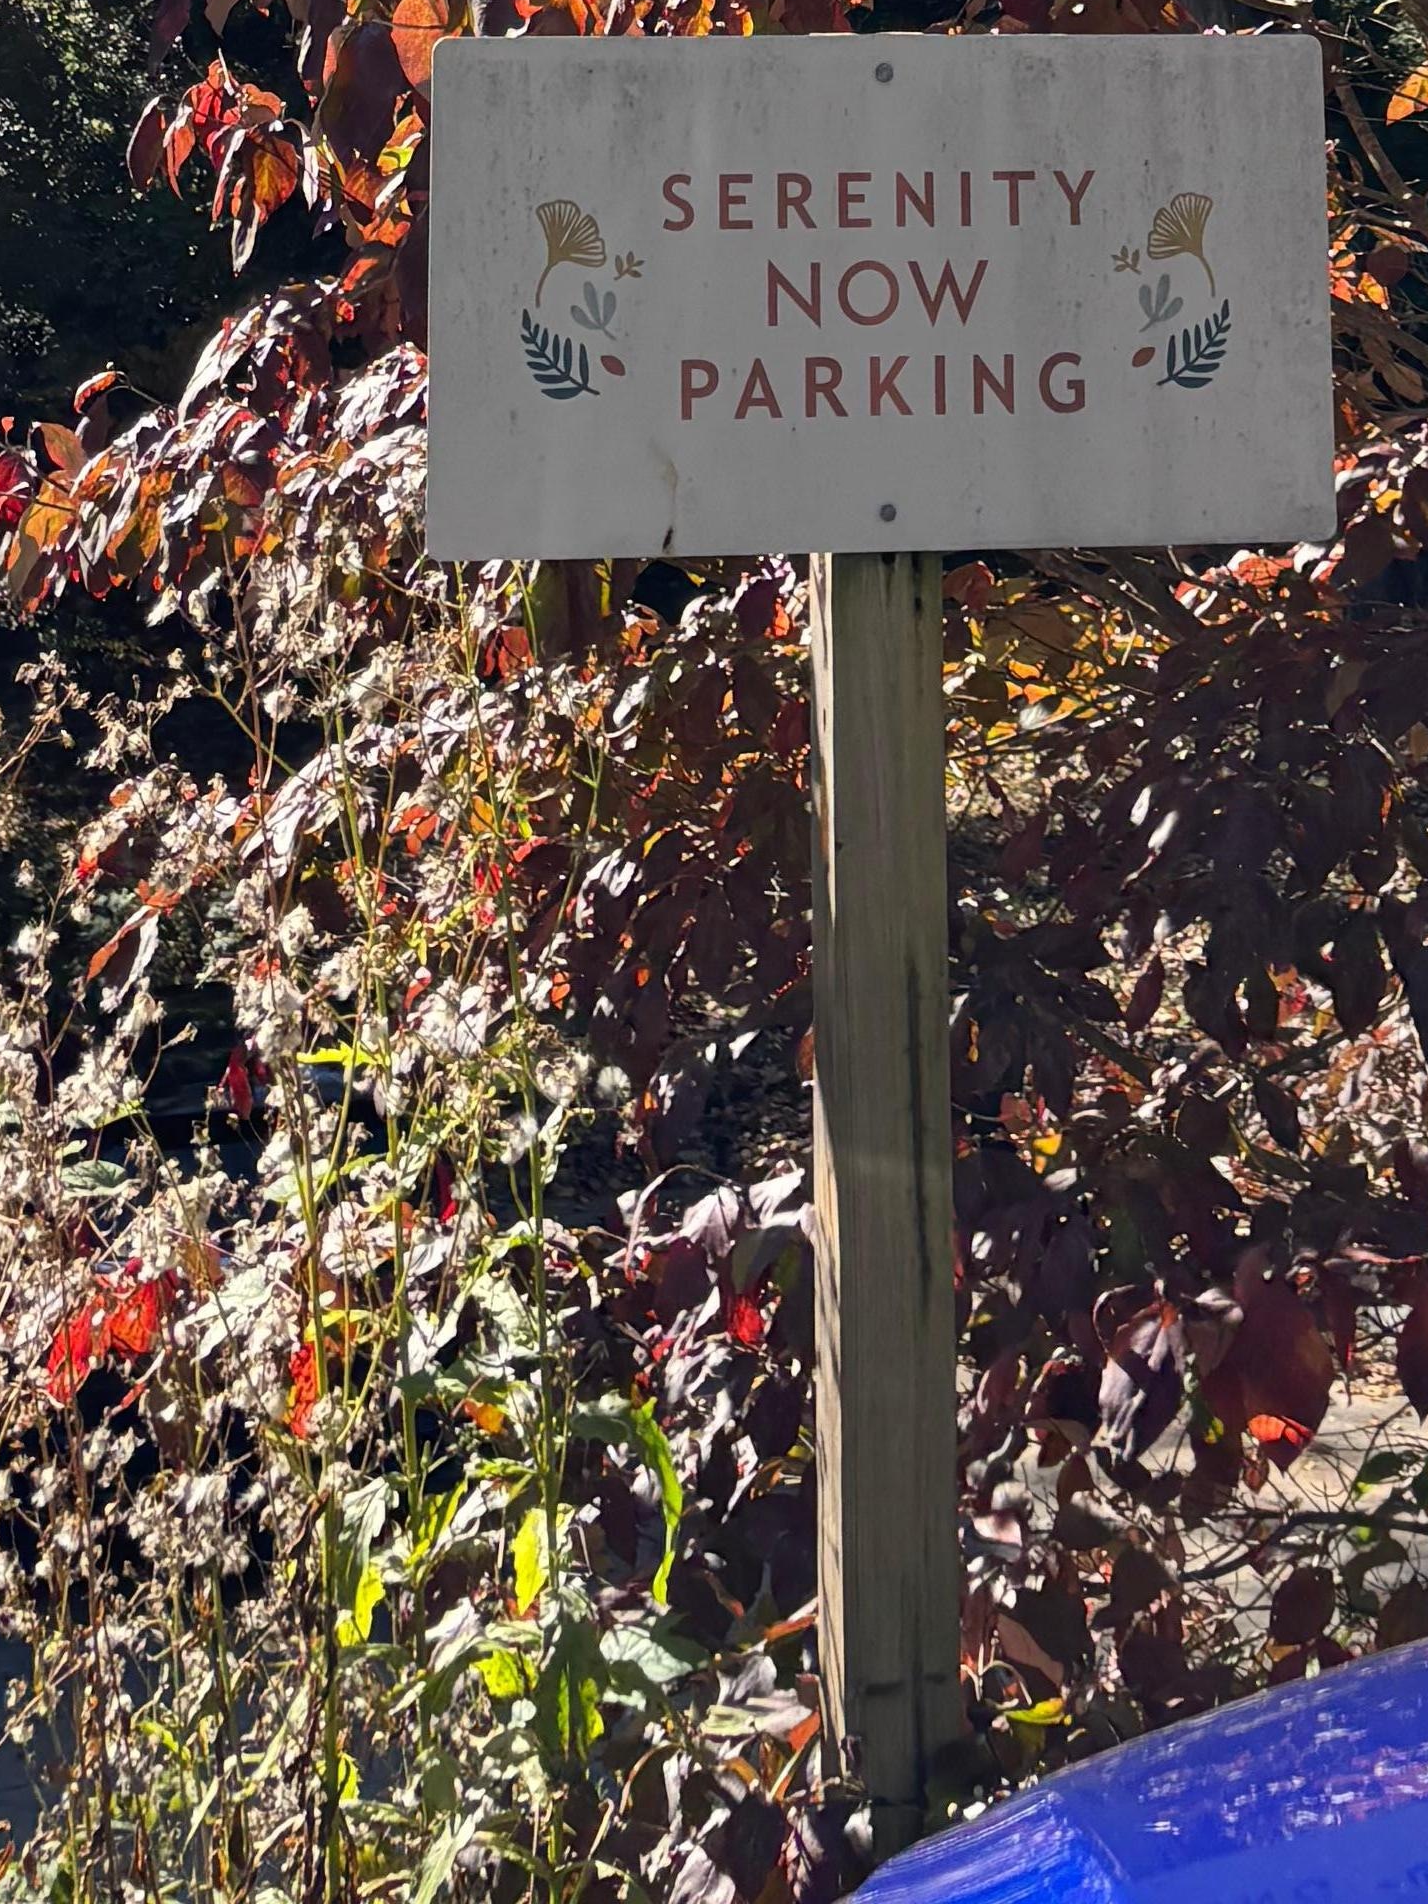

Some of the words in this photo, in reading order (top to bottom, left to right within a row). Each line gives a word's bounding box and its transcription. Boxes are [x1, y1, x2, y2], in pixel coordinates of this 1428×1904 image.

[662, 169, 1096, 232] SERENITY
[767, 259, 989, 327] NOW
[680, 352, 1086, 420] PARKING
